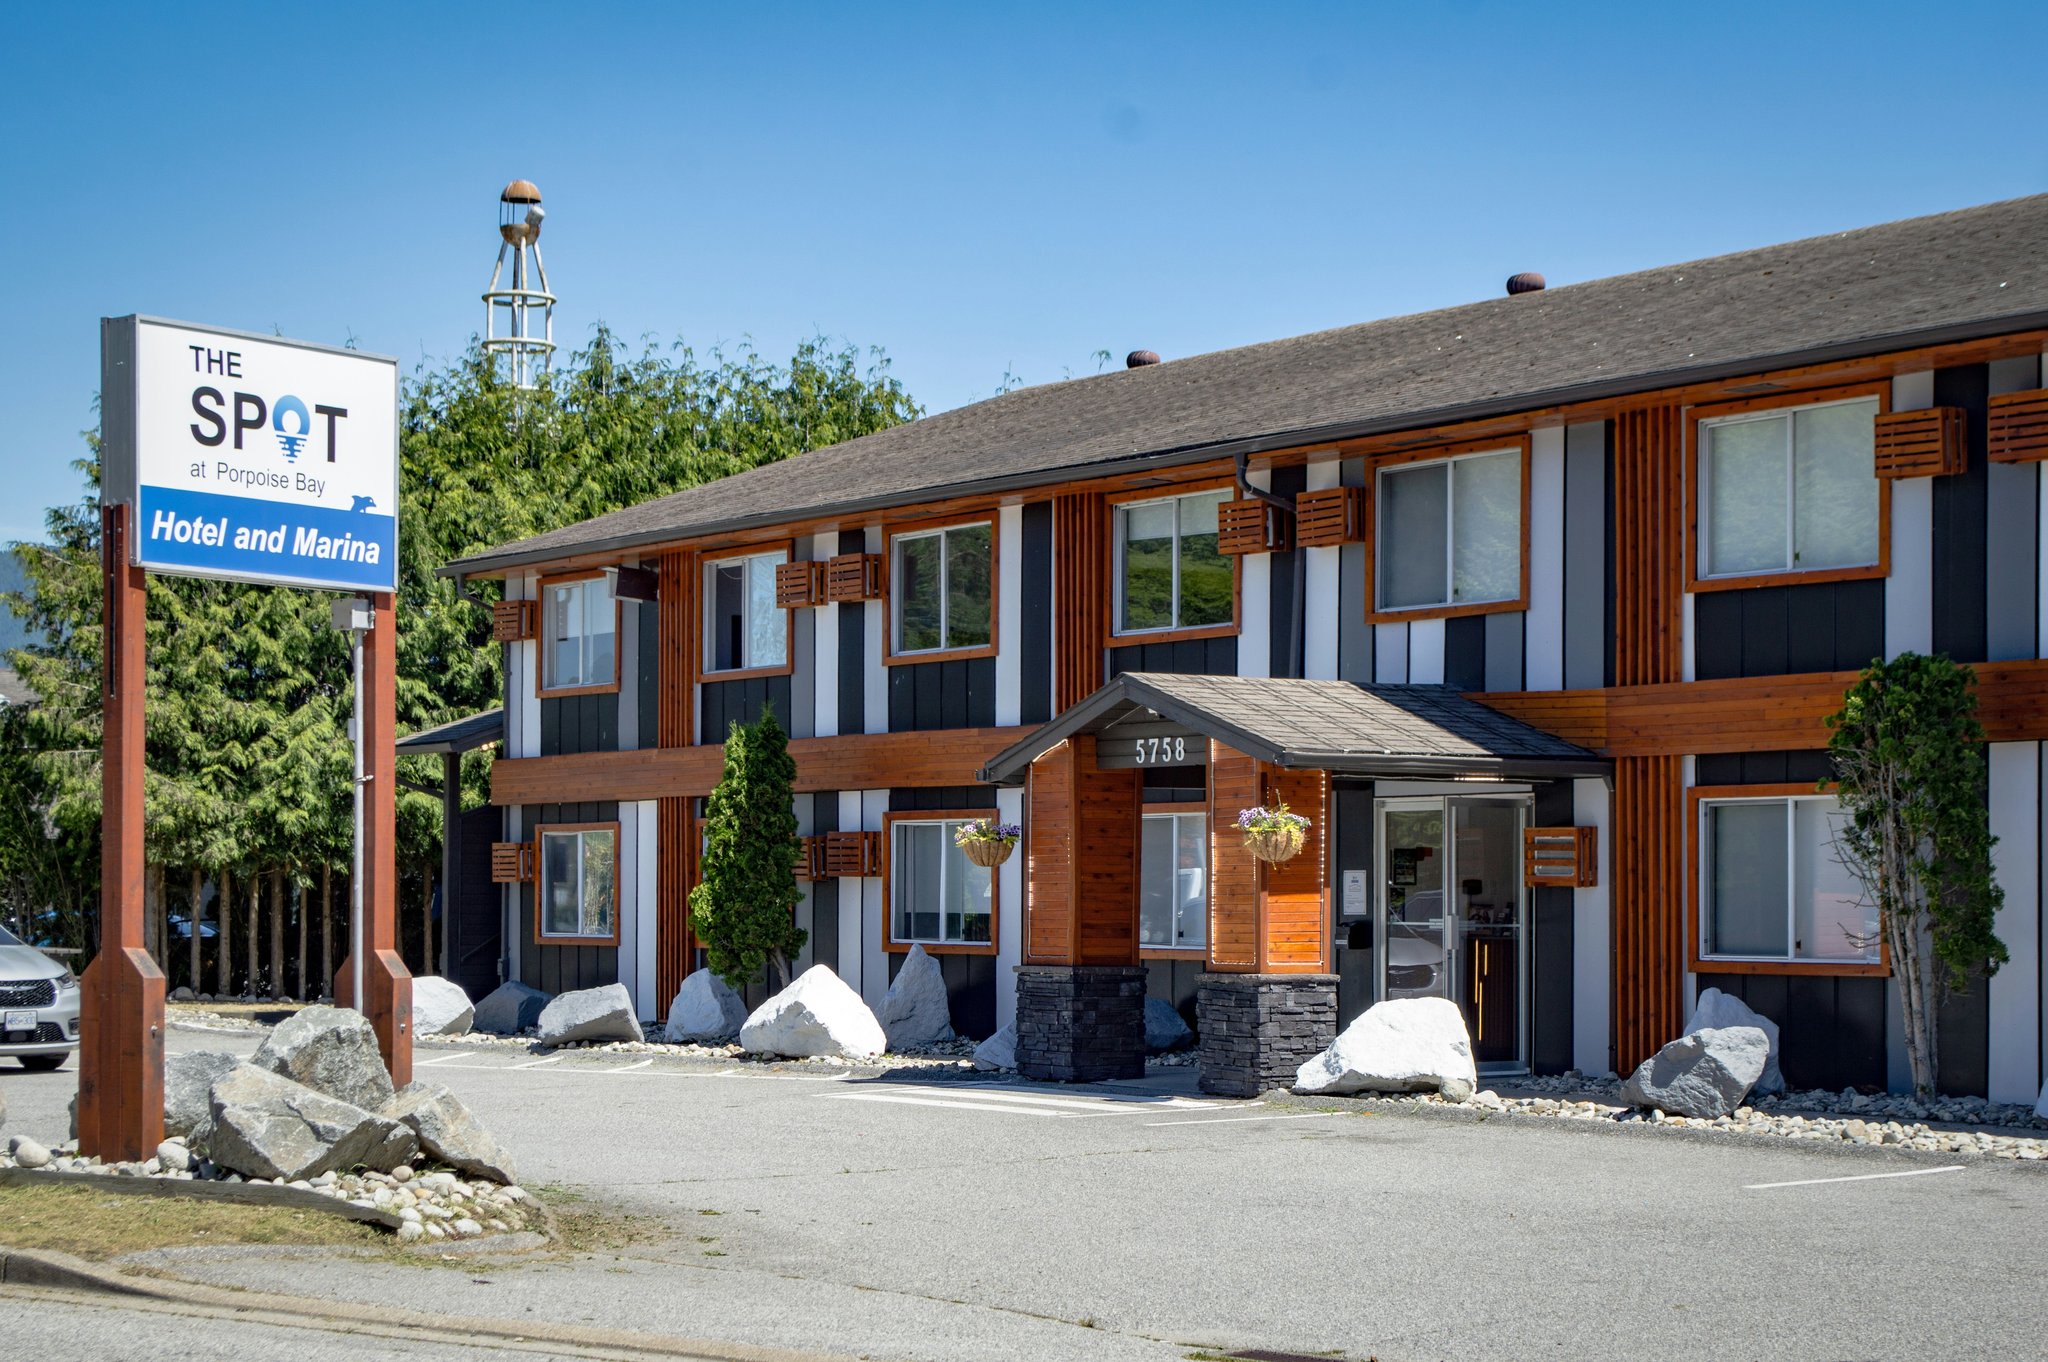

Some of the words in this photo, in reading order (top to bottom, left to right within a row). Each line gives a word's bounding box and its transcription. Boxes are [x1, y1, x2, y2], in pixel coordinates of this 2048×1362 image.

[189, 345, 242, 378] THE
[190, 386, 348, 464] SPOT
[190, 460, 206, 478] at
[217, 462, 289, 489] Porpoise
[296, 472, 326, 497] Bay
[151, 510, 228, 547] Hotel
[234, 525, 287, 554] and
[292, 526, 381, 564] Marina
[1135, 737, 1185, 763] 5758
